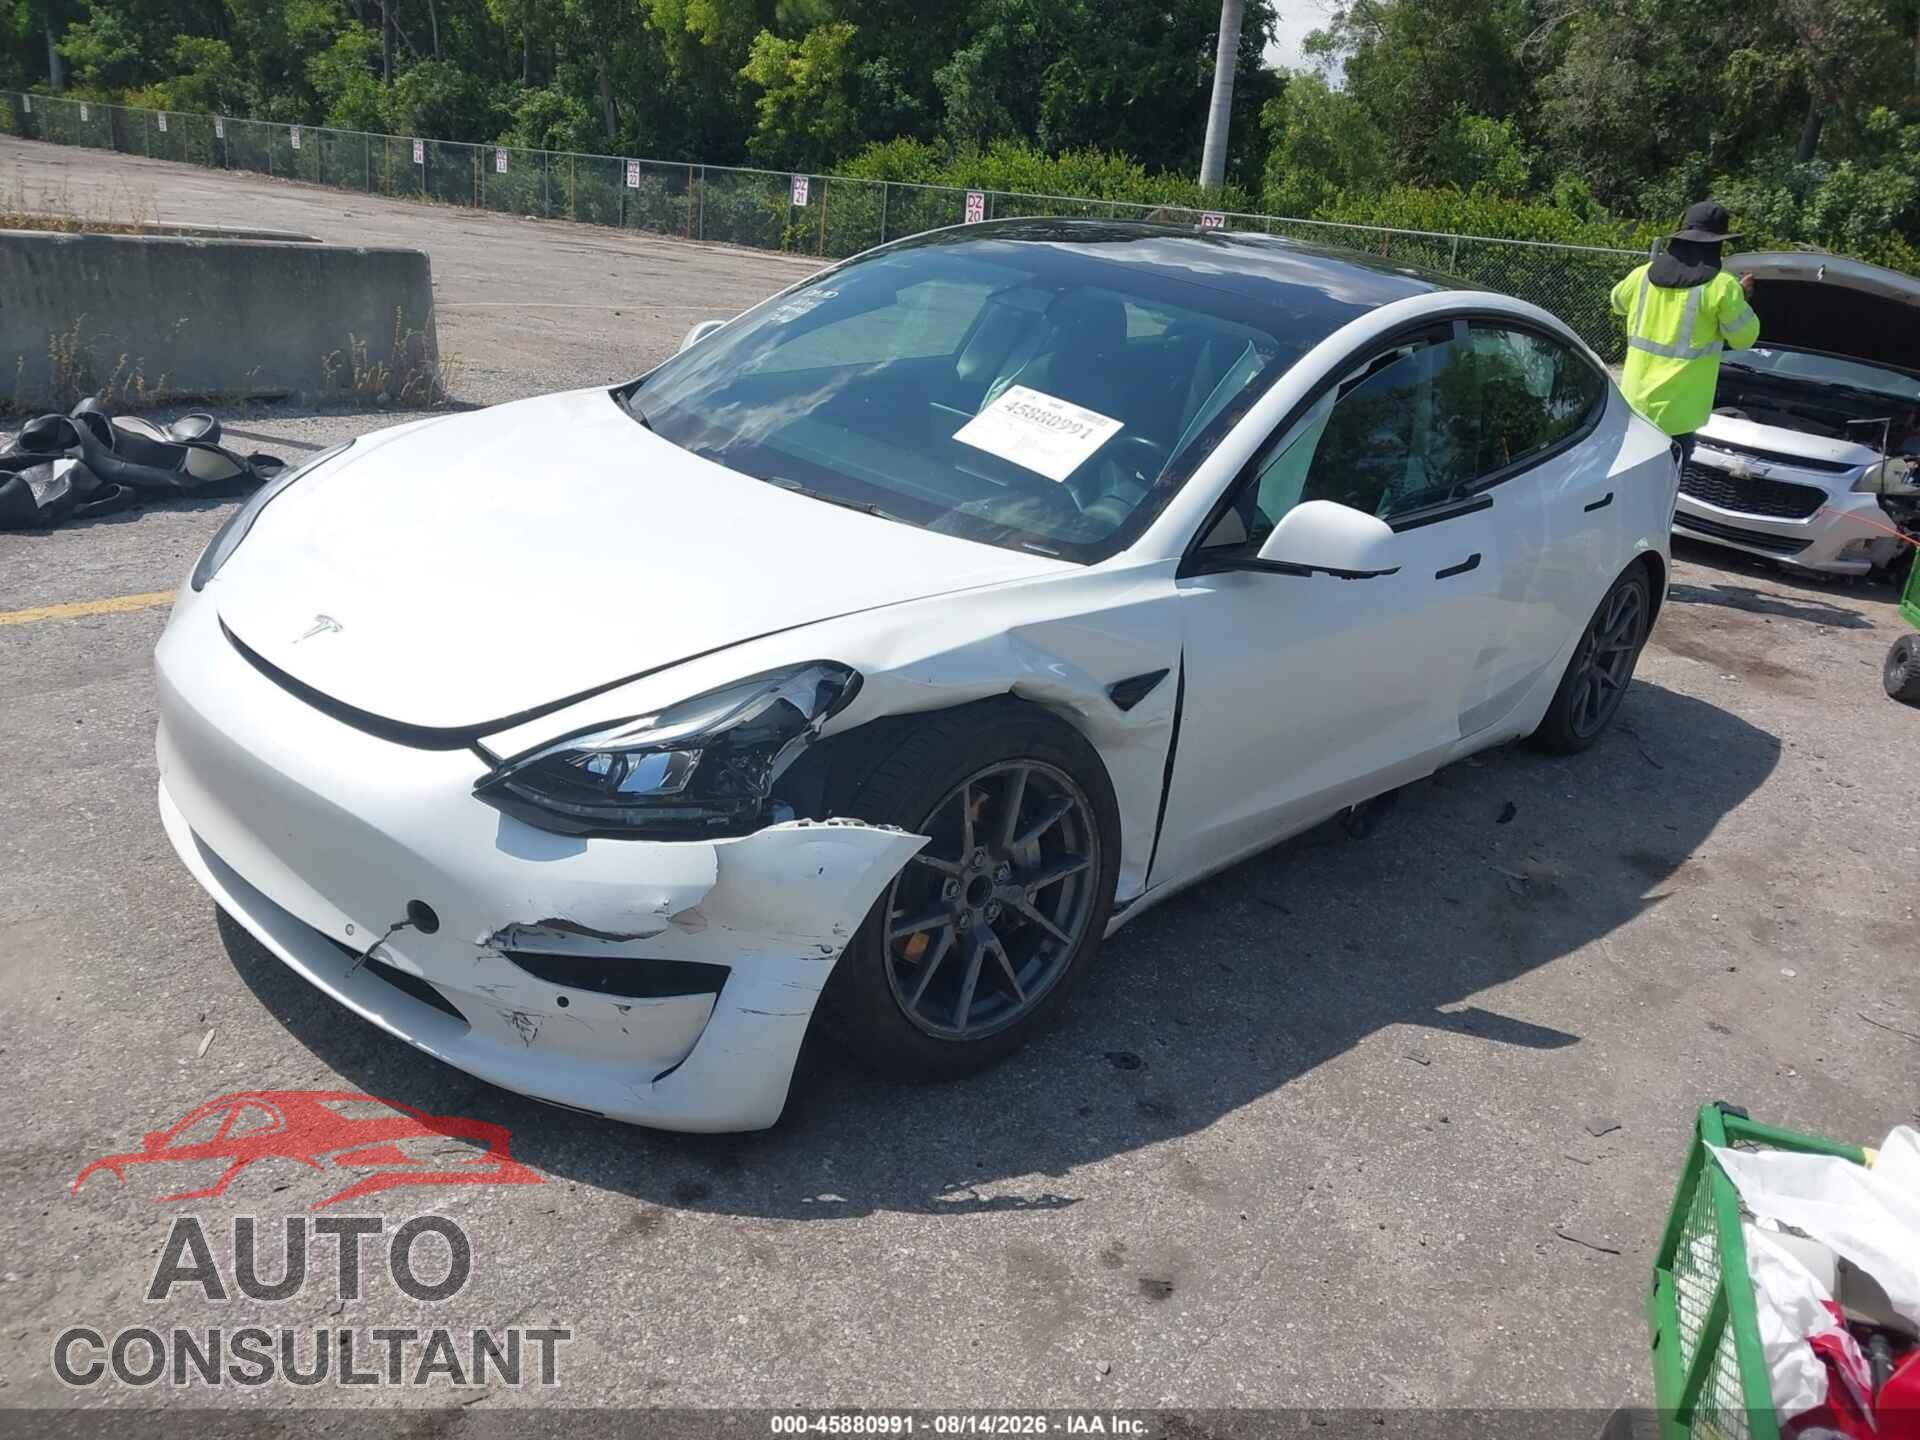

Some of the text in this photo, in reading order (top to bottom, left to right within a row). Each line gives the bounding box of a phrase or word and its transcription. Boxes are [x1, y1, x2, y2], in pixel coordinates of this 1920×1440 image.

[794, 177, 808, 190] DZ
[795, 191, 805, 204] 21
[967, 194, 983, 209] DZ
[967, 209, 981, 223] 20
[1004, 401, 1094, 440] 45880991
